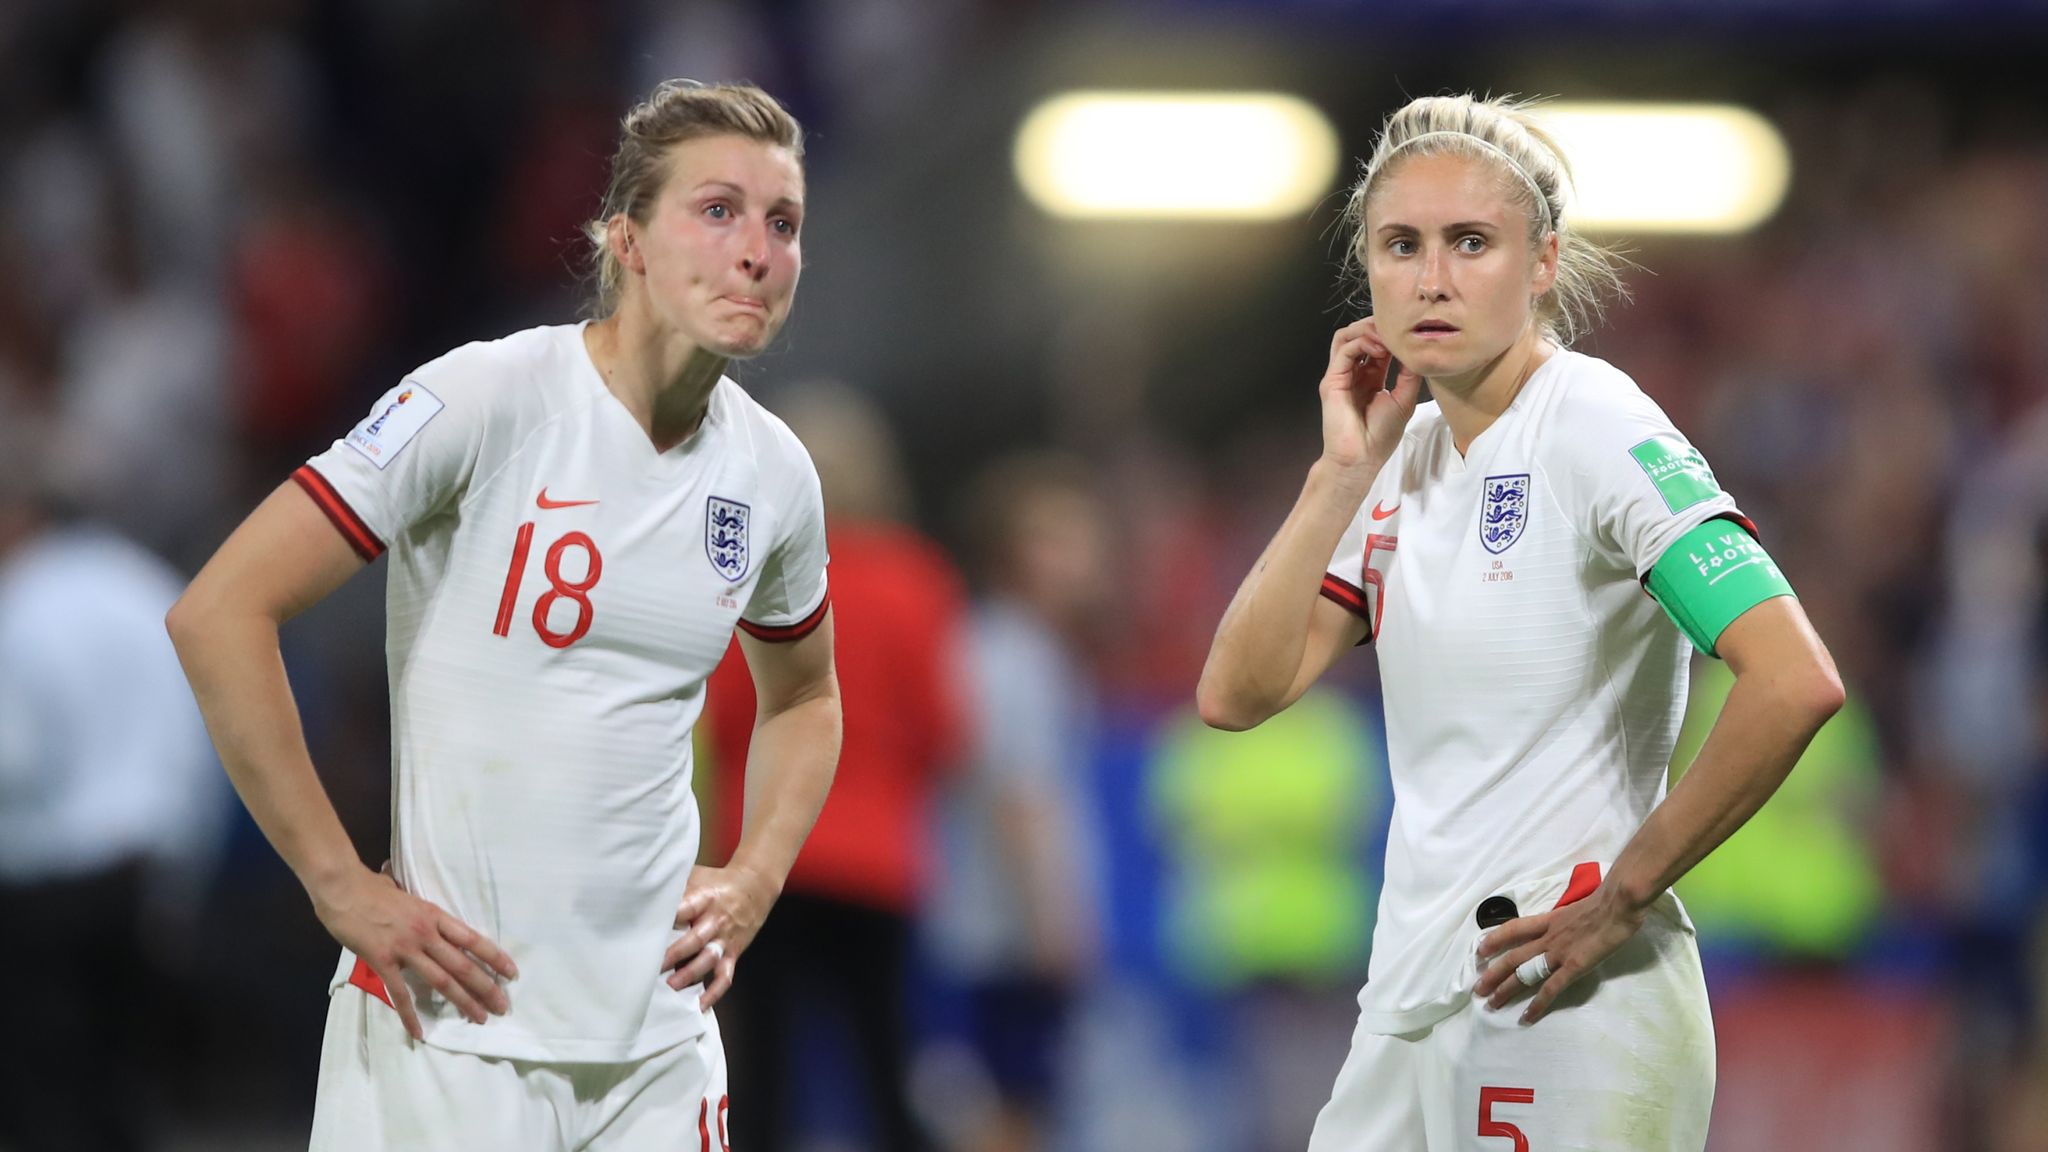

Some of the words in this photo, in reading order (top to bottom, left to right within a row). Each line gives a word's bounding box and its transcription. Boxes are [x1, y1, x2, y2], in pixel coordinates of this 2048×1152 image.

[1689, 532, 1748, 564] LIVI
[1698, 543, 1760, 577] FOOTB
[1488, 571, 1500, 582] JULY
[1491, 560, 1504, 570] USA
[492, 521, 603, 649] 18
[1478, 1086, 1534, 1152] 5
